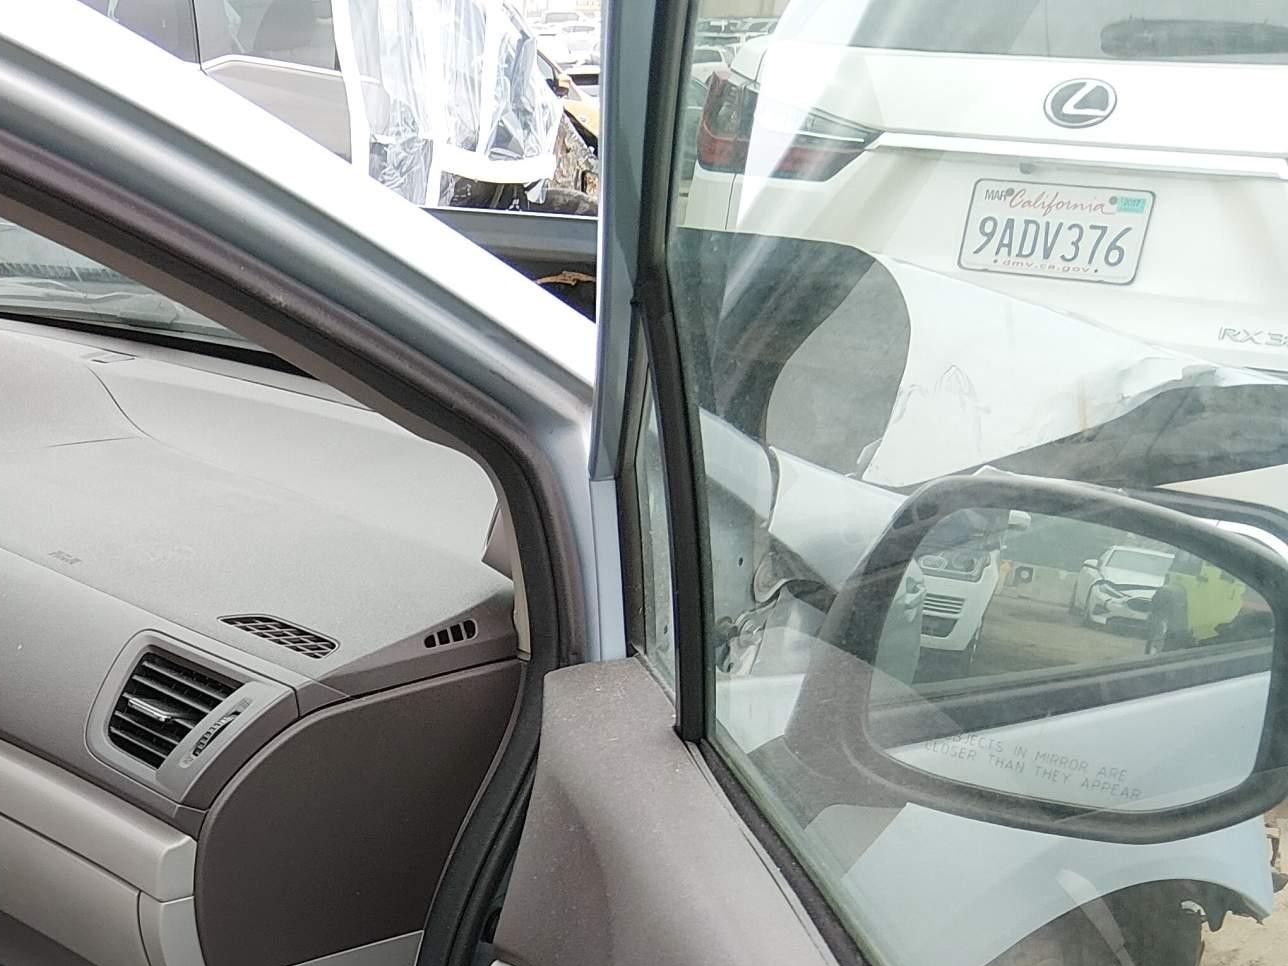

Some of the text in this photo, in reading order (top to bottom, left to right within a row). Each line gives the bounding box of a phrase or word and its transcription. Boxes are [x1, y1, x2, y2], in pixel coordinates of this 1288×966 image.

[1009, 188, 1116, 217] California
[972, 216, 1133, 267] 9ADV376
[1218, 327, 1263, 345] RX
[988, 753, 1025, 774] THAN
[1034, 765, 1070, 784] THEY
[1080, 777, 1143, 799] APPEAR
[1014, 745, 1025, 759] IN
[1034, 750, 1089, 772] MIRROR
[1095, 766, 1128, 782] ARE
